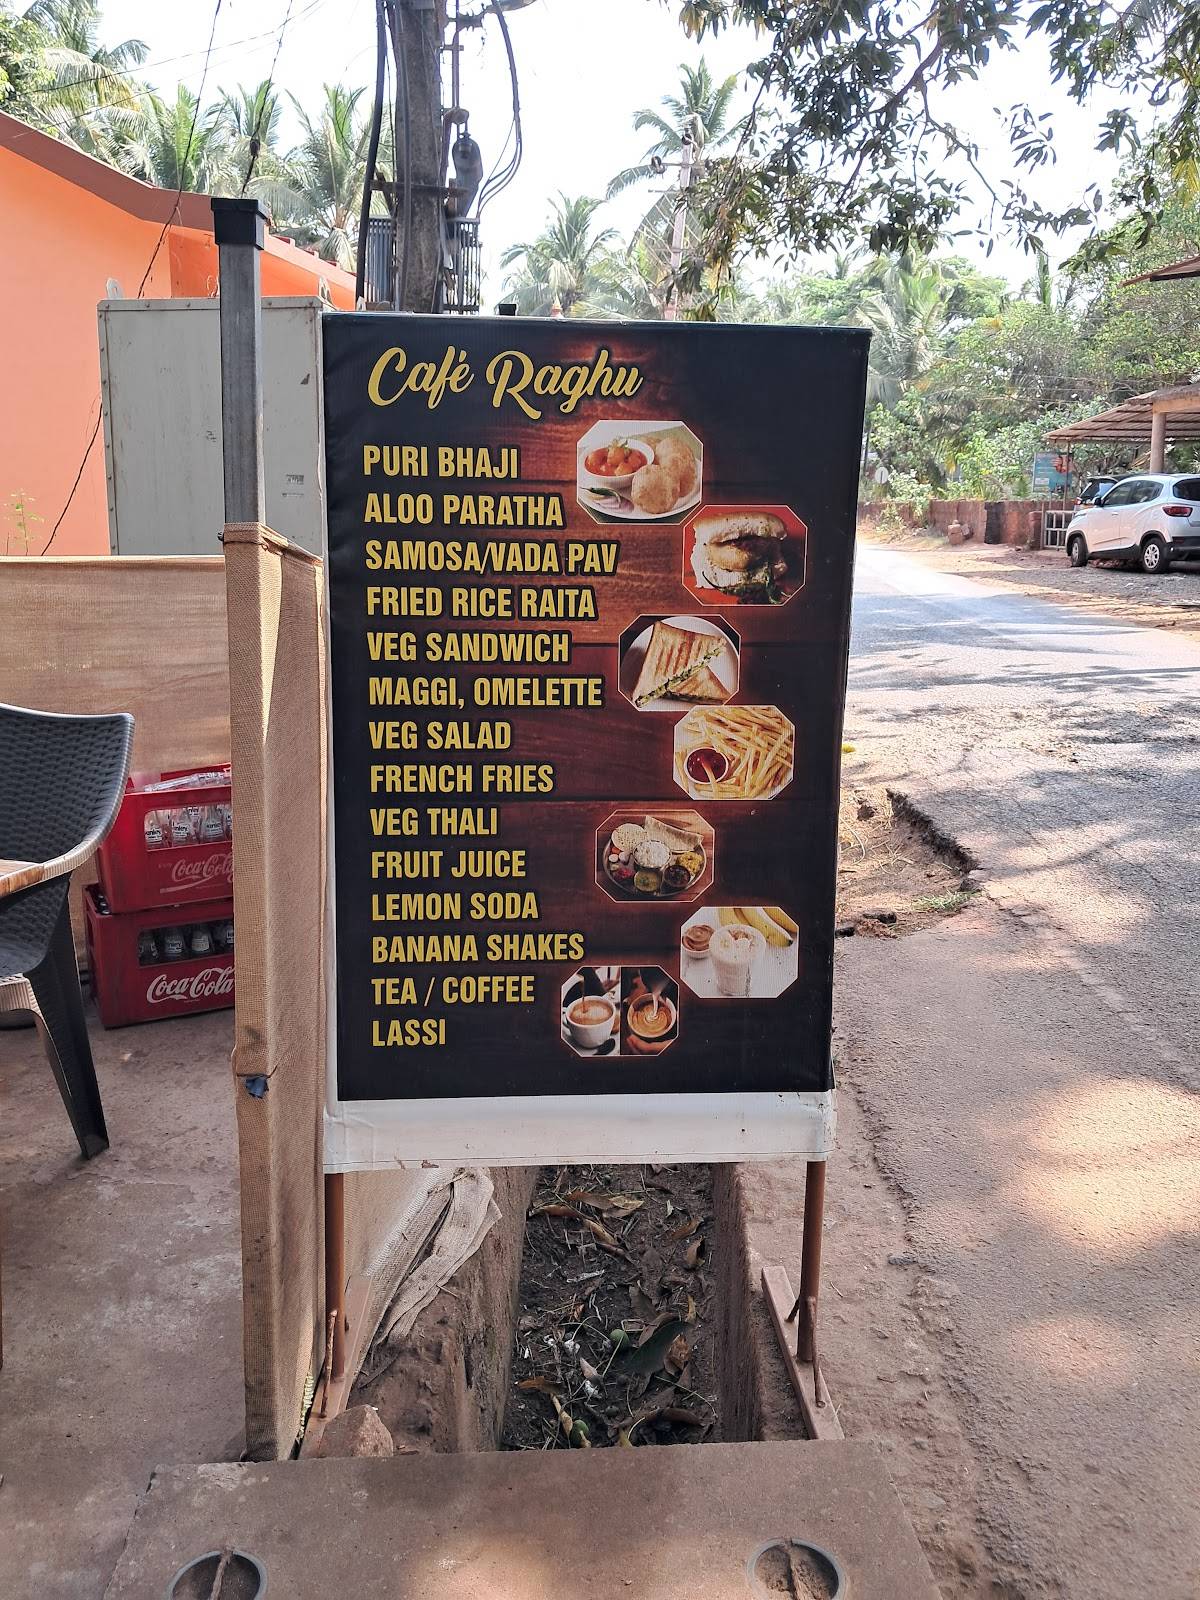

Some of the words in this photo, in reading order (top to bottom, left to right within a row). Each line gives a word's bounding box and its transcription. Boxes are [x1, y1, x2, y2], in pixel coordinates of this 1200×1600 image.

[368, 346, 474, 409] Café
[486, 350, 643, 420] Raghu
[364, 445, 427, 476] PURI
[439, 448, 517, 478] BHAJI
[365, 493, 433, 524] ALOO
[444, 495, 562, 526] PARATHA
[366, 540, 559, 574] SAMOSA/VADA
[569, 544, 616, 572] PAV
[367, 587, 442, 616] FRIED
[453, 588, 511, 616] RICE
[522, 589, 594, 617] RAITA
[367, 632, 416, 661] VEG
[426, 633, 568, 662] SANDWICH
[369, 677, 464, 708] MAGGI,
[474, 678, 600, 705] OMELETTE
[369, 721, 417, 749] VEG
[427, 722, 510, 749] SALAD
[371, 765, 472, 792] FRENCH
[483, 765, 553, 792] FRIES
[370, 808, 418, 835] VEG
[427, 808, 497, 835] THALI
[372, 851, 442, 878] FRUIT
[452, 850, 525, 877] JUICE
[373, 893, 460, 920] LEMON
[470, 893, 538, 919] SODA
[373, 935, 478, 963] BANANA
[487, 933, 584, 960] SHAKES
[147, 967, 235, 1003] Coca-Cola
[371, 978, 417, 1004] TEA
[424, 978, 435, 1006] /
[443, 976, 534, 1003] COFFEE
[373, 1019, 445, 1046] LASSI
